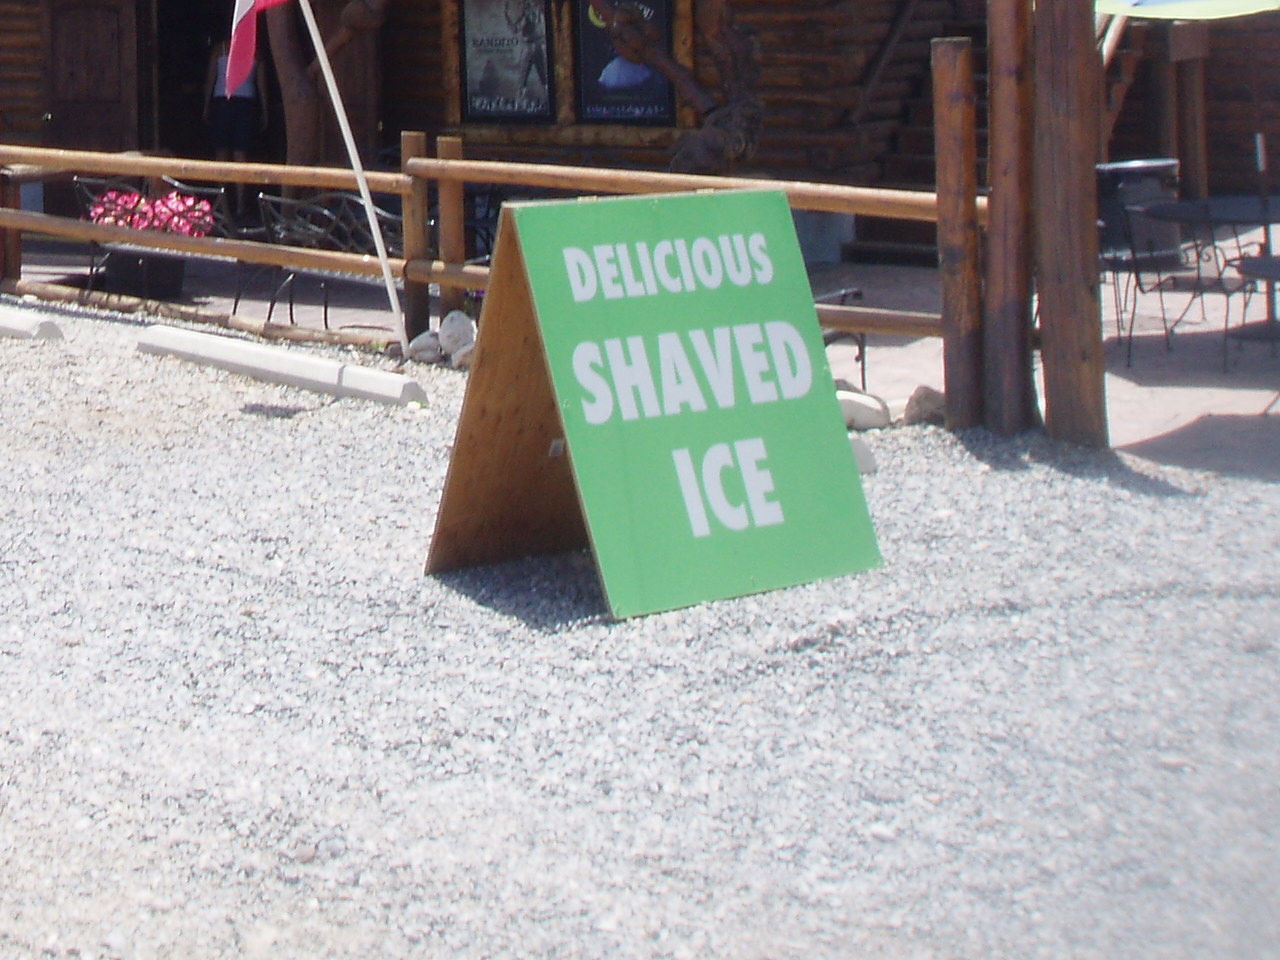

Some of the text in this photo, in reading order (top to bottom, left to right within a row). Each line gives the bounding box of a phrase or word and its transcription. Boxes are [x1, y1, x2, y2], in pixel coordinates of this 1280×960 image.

[562, 232, 774, 303] DELICIOUS
[572, 320, 812, 425] SHAVED
[672, 437, 785, 538] ICE
